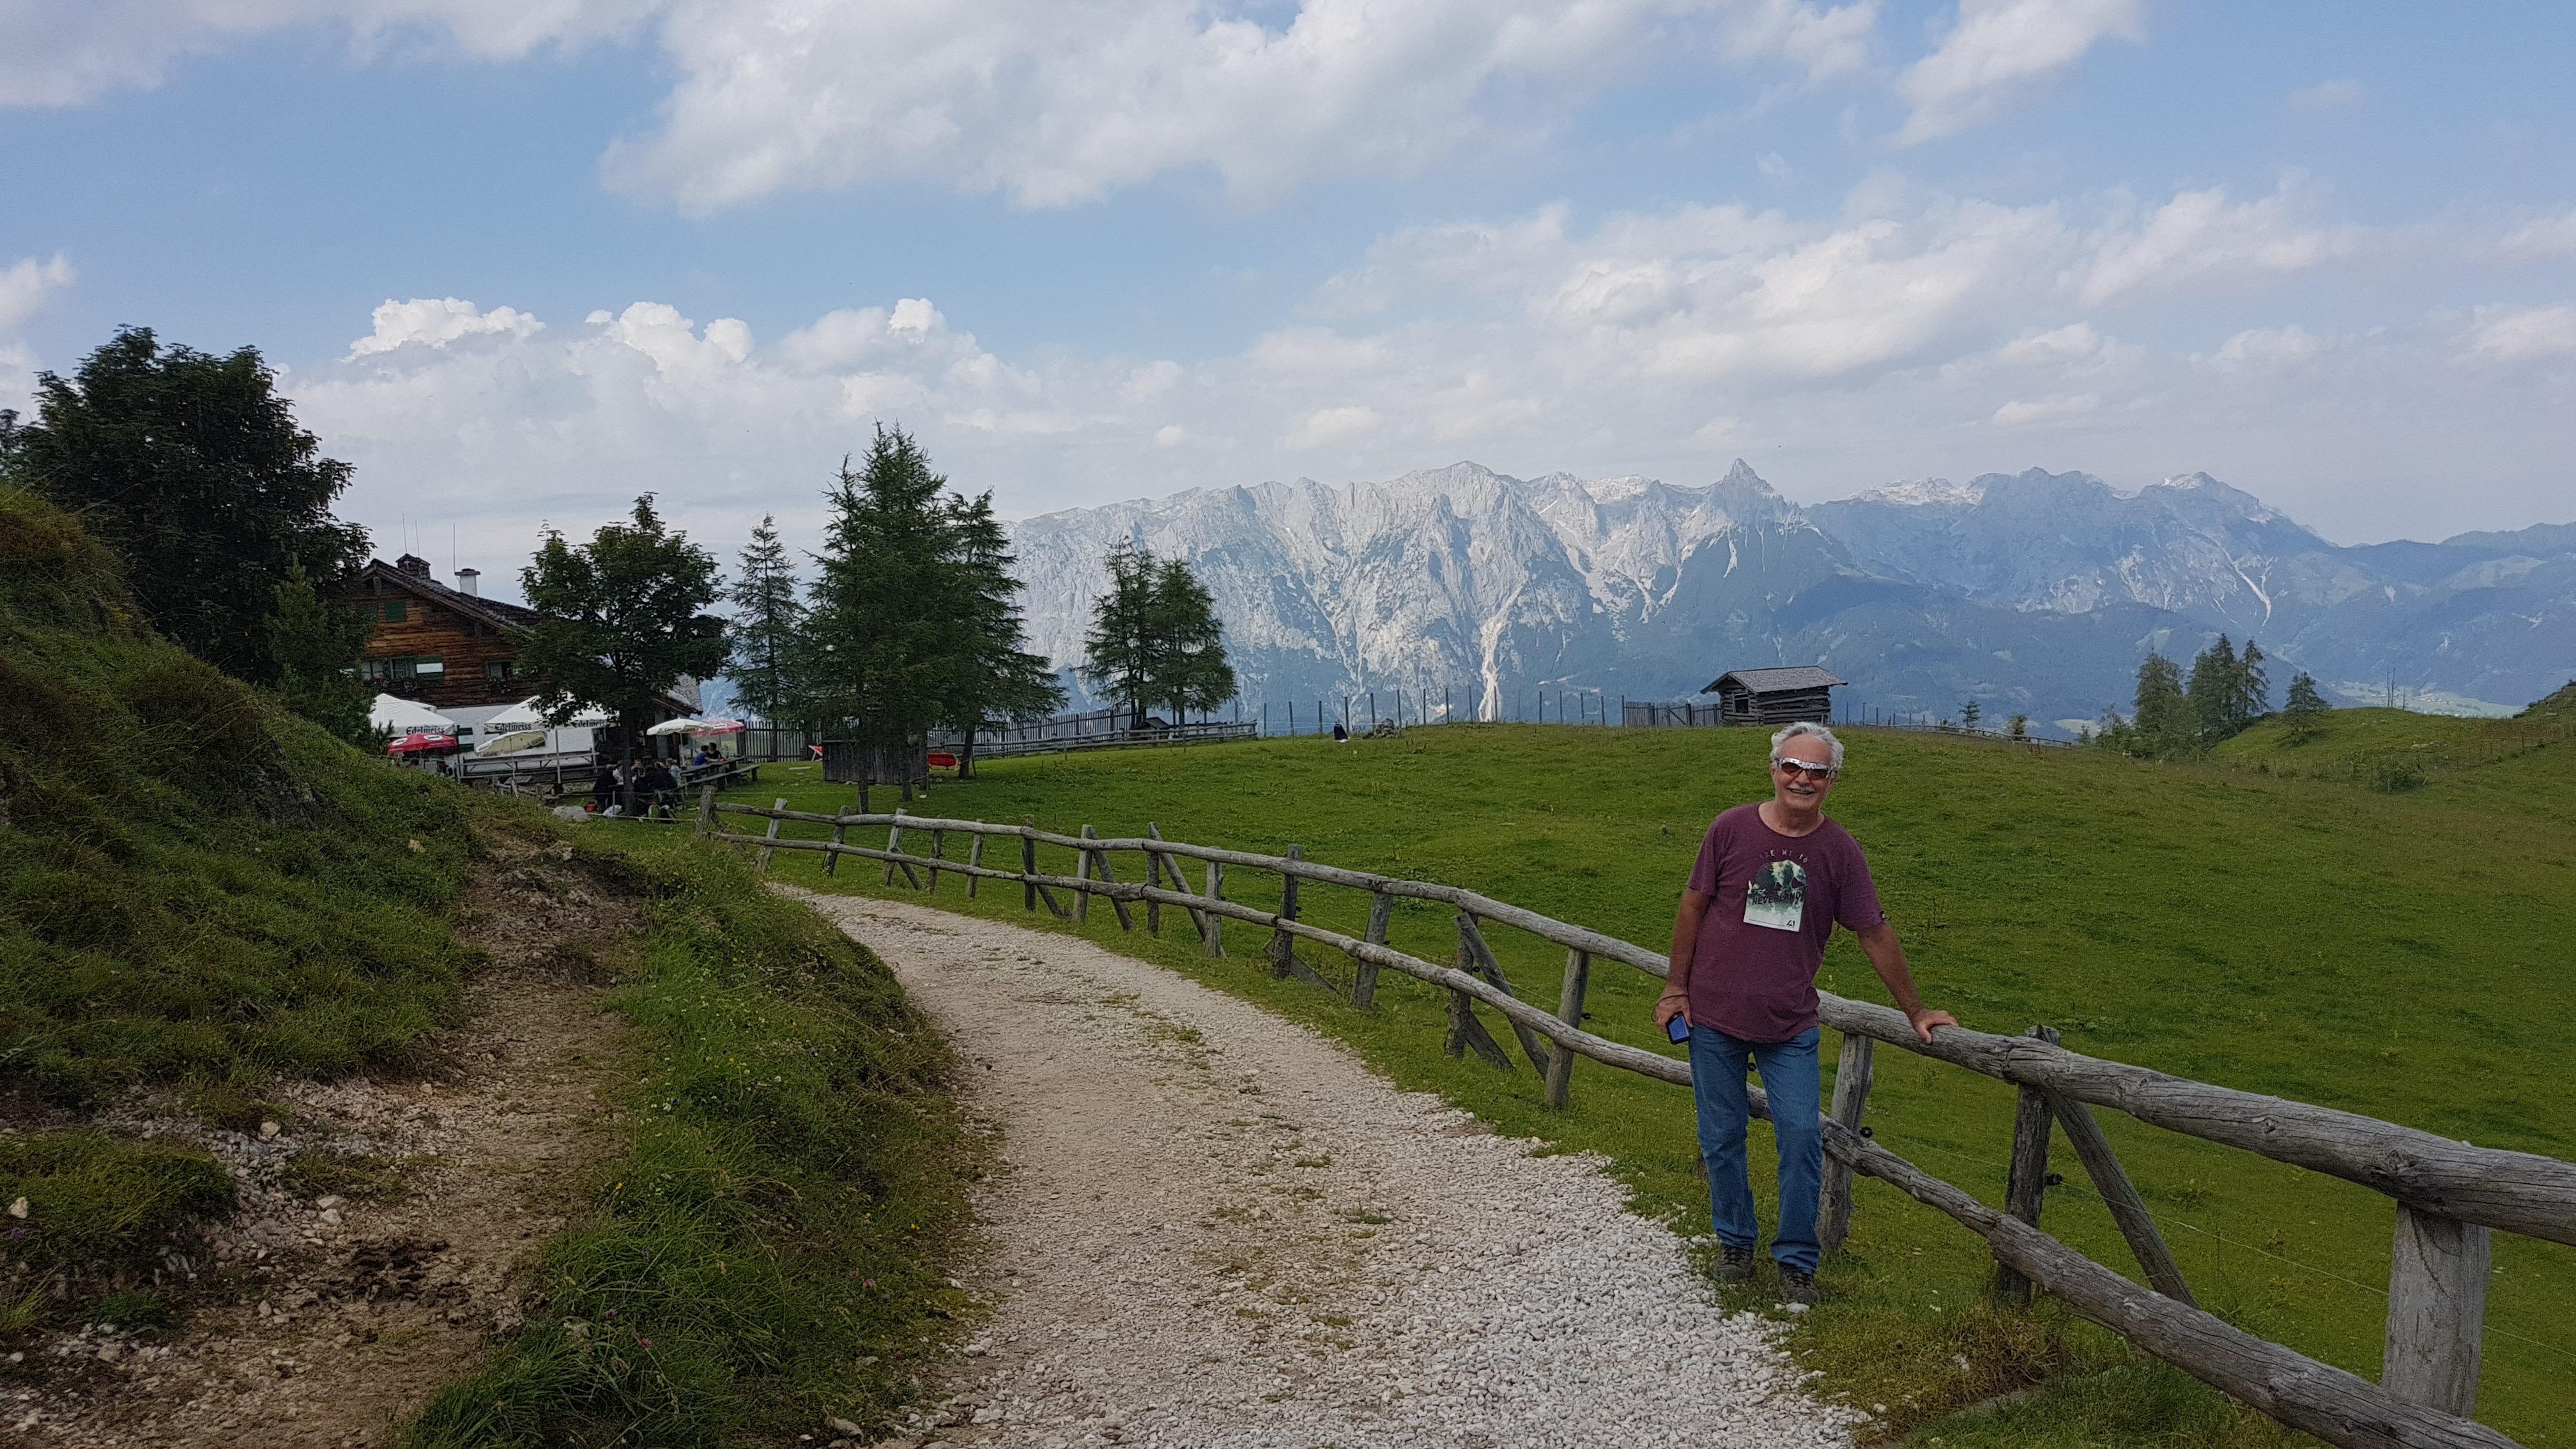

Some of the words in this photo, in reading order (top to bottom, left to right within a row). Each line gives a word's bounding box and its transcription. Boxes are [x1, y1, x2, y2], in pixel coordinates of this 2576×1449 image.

[495, 723, 532, 731] Edelweiss
[572, 719, 608, 728] Edelweis
[406, 726, 445, 735] Edelweiss
